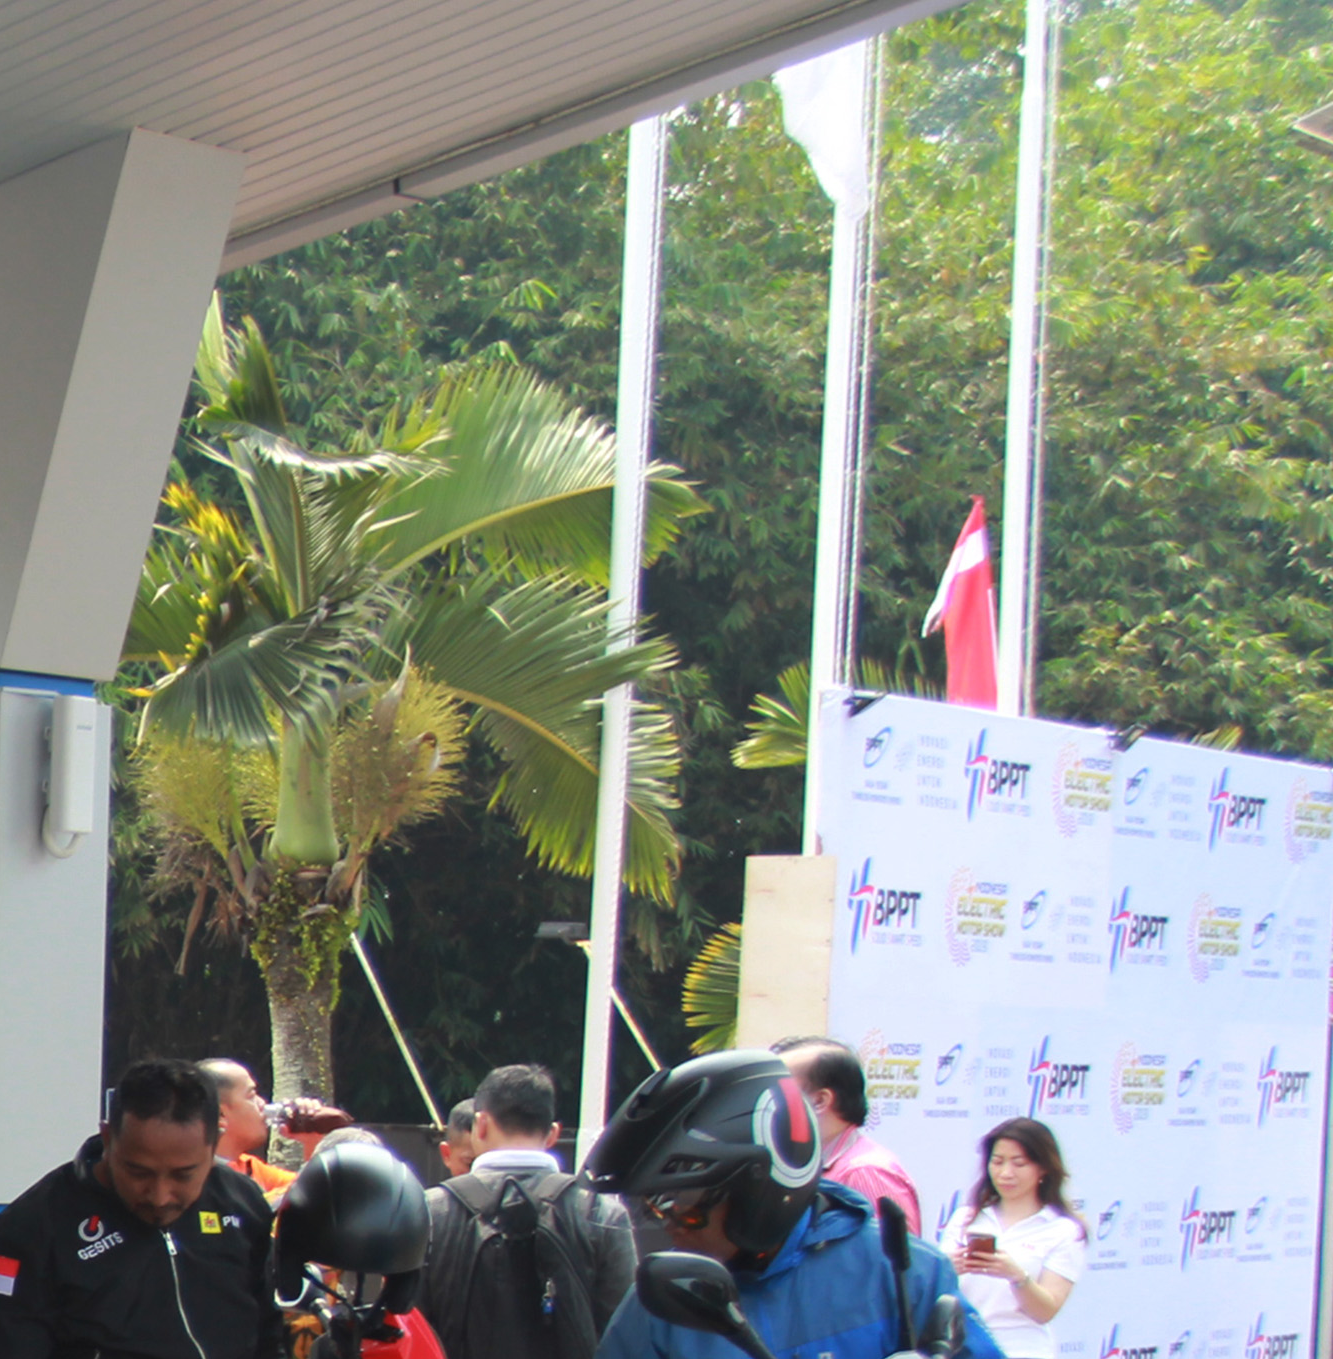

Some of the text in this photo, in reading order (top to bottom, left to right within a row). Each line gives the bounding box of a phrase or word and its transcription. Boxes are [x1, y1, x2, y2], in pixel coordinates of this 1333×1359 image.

[987, 758, 1032, 799] BPPT
[1227, 793, 1269, 831] BPPT
[873, 888, 923, 929] BPPT
[1128, 913, 1170, 950] BPPT
[866, 1058, 922, 1081] ELECTRIC
[1047, 1063, 1091, 1100] BPPT
[1274, 1070, 1311, 1104] BPPT
[77, 1231, 125, 1261] GESITS
[1198, 1210, 1236, 1245] BPPT
